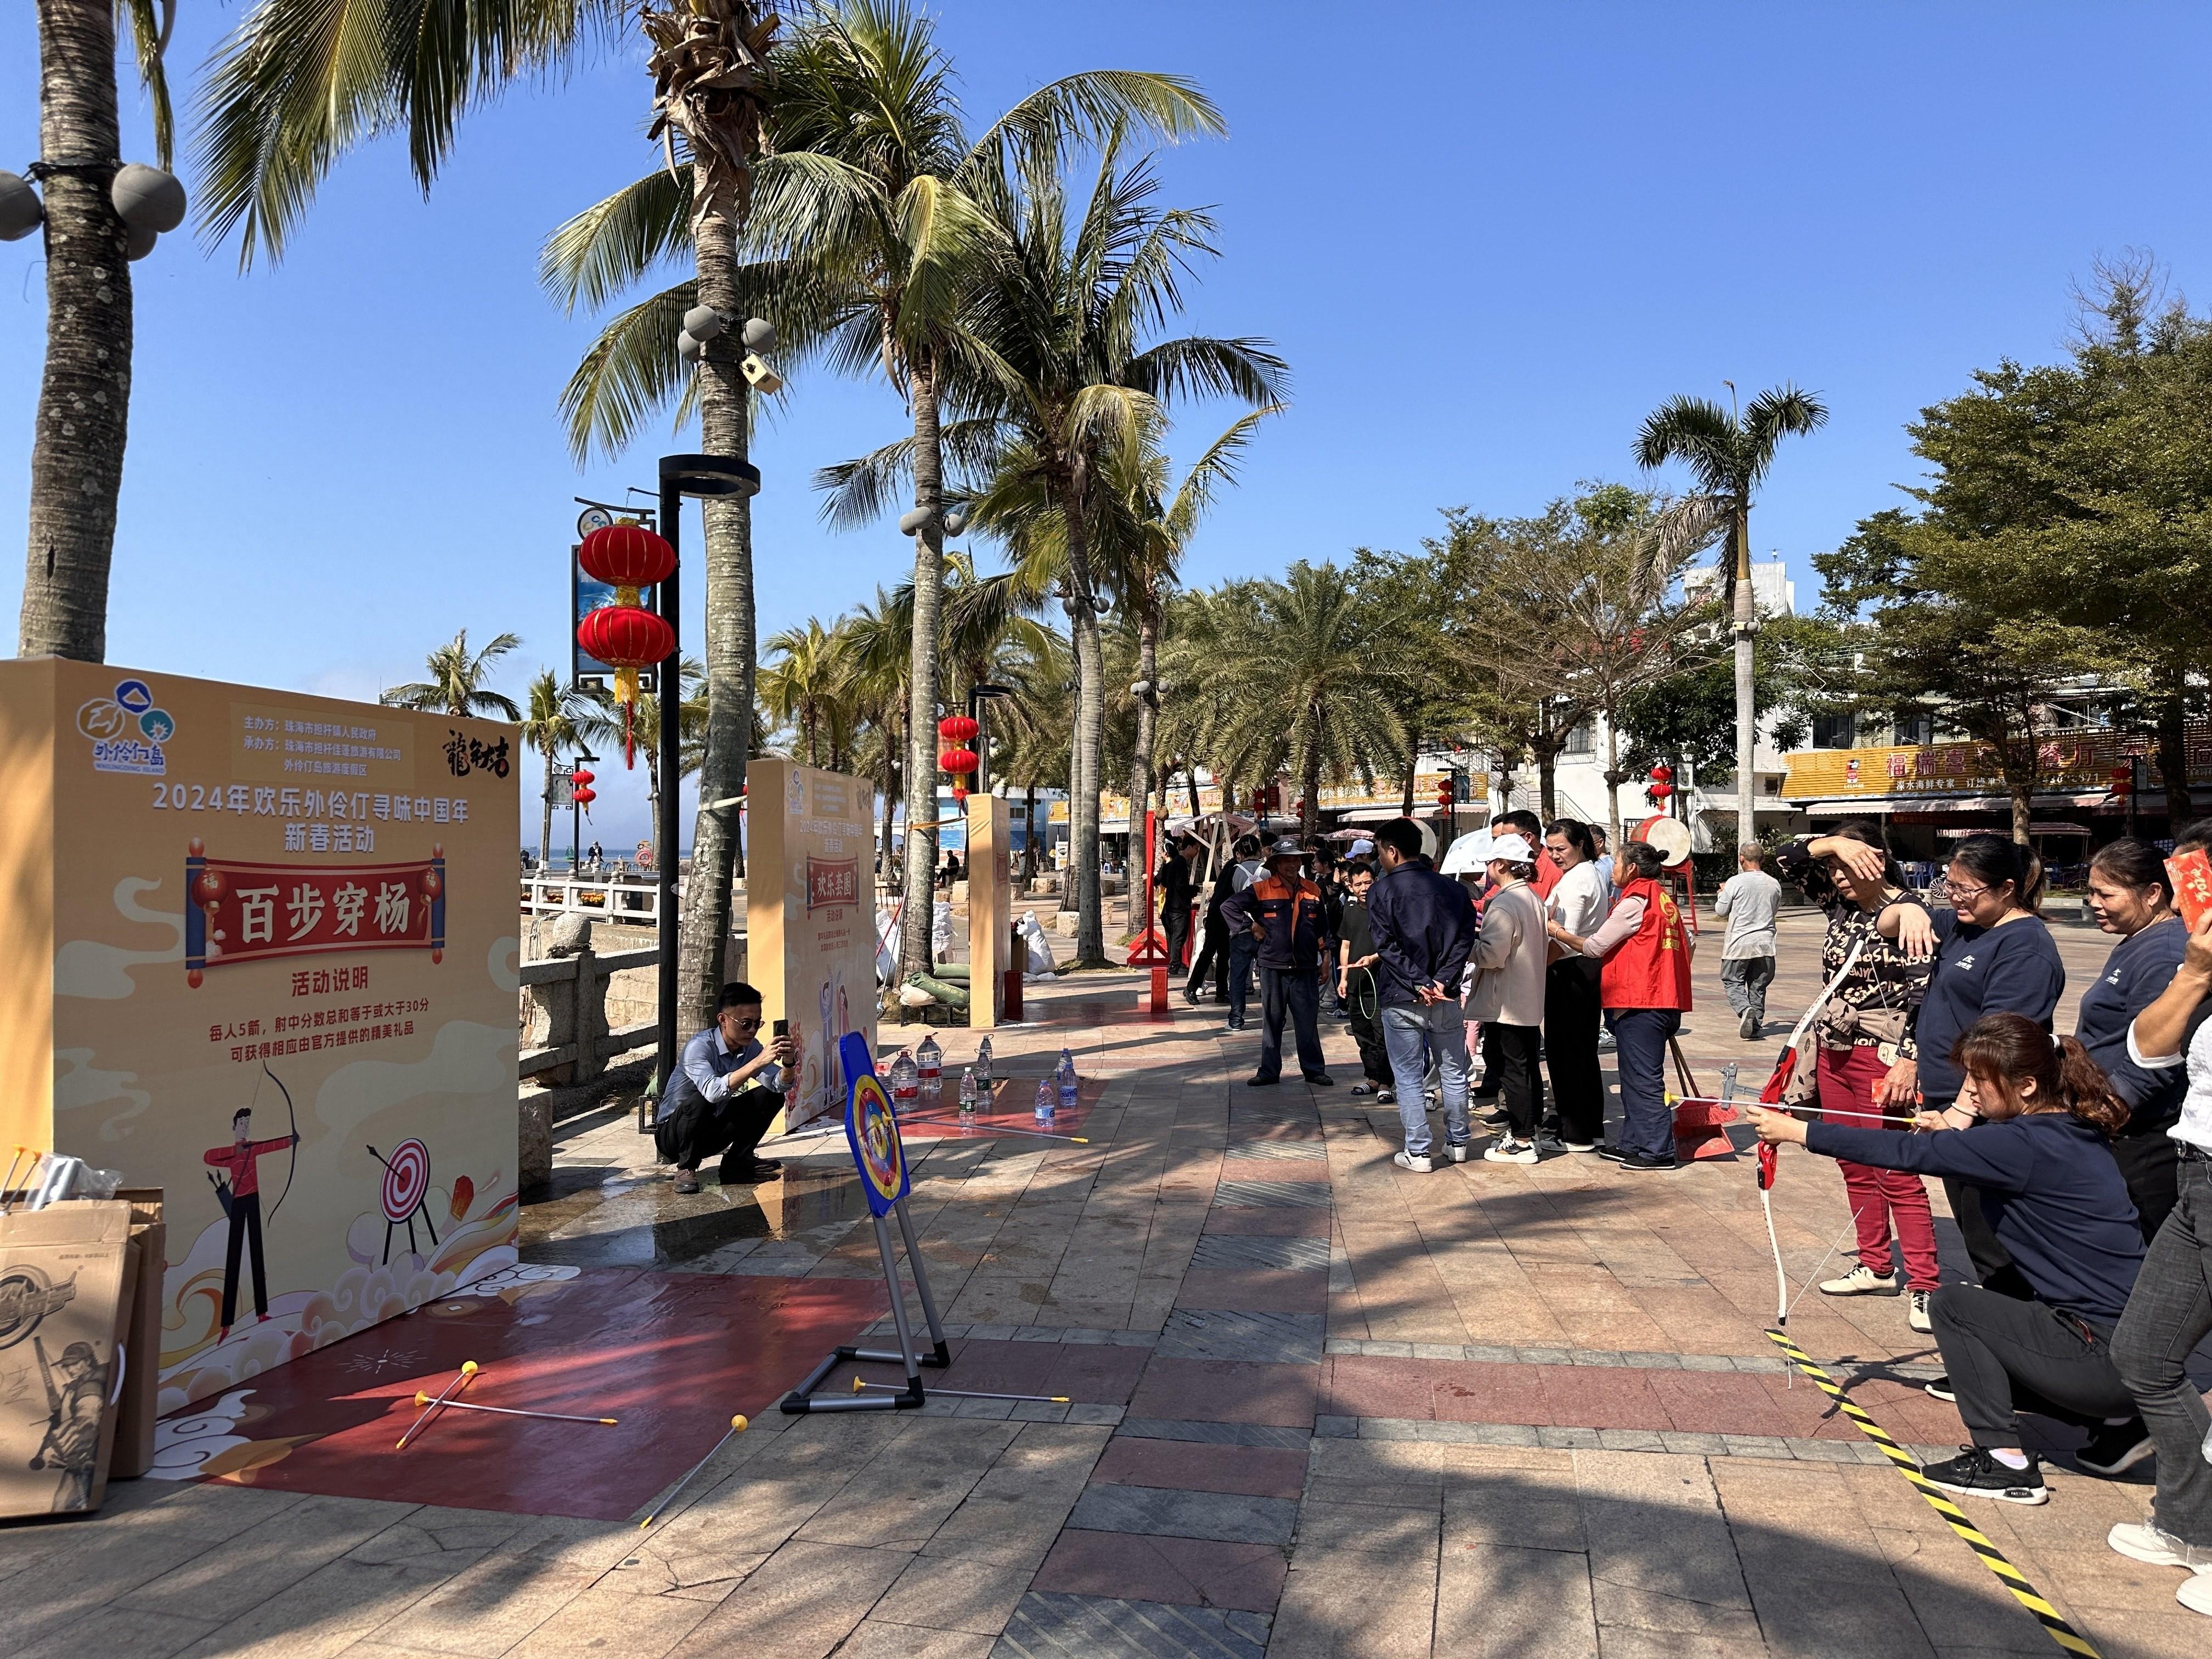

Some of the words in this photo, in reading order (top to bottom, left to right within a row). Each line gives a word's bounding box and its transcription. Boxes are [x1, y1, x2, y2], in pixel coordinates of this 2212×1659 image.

[94, 742, 165, 766] 外伶仃岛
[284, 759, 367, 776] 外伶仃岛旅游度假区
[1896, 778, 1955, 791] 深水海鲜专家
[153, 782, 469, 824] 2024年欢乐外伶仃寻味中国年
[285, 823, 375, 854] 新春活动
[202, 874, 219, 889] 福
[426, 871, 436, 888] 福
[817, 871, 851, 898] 欢乐套圈
[235, 881, 410, 944] 百步穿杨
[291, 966, 369, 997] 活动说明
[230, 1020, 414, 1063] 可获得相应由官方提供的精美礼品
